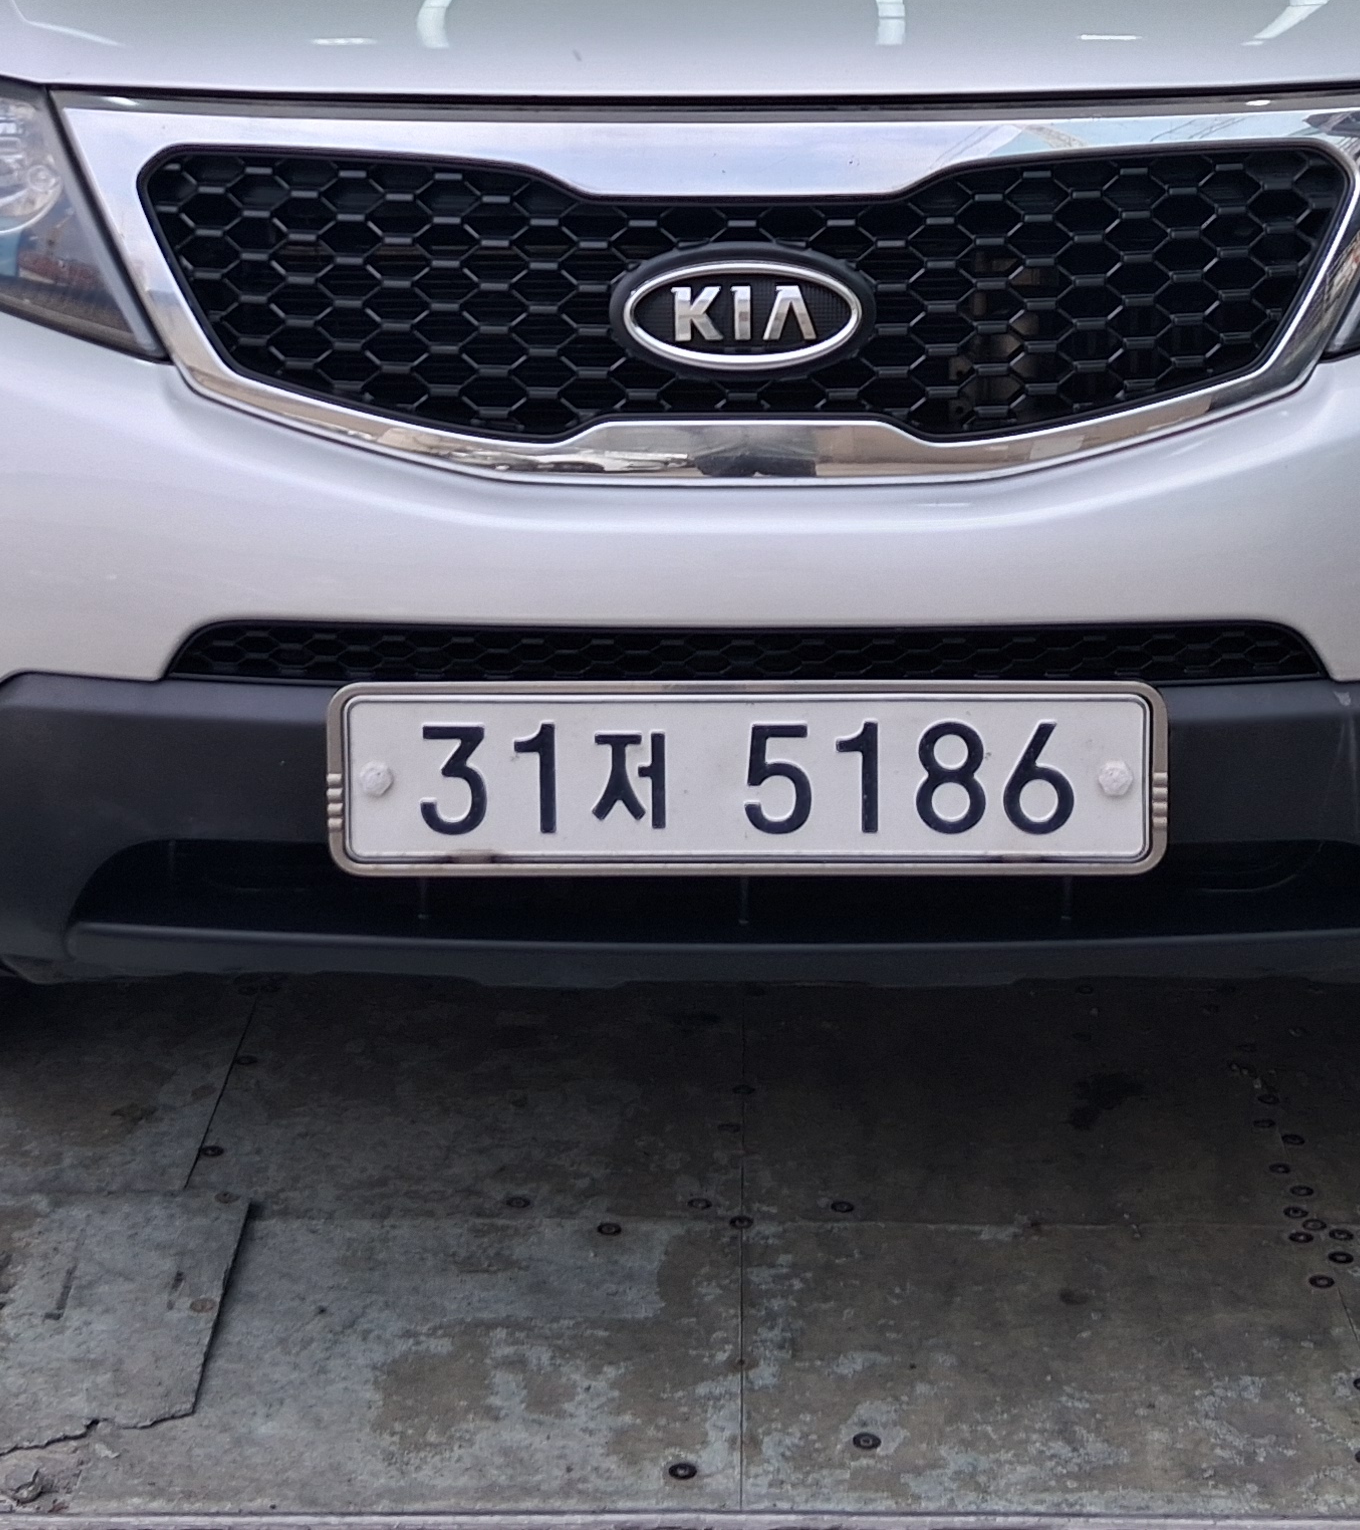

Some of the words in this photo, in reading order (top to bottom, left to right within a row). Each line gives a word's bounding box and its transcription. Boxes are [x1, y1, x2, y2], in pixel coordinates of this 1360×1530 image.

[670, 285, 817, 341] KIA
[419, 721, 666, 836] 31저
[744, 719, 1076, 836] 5186
